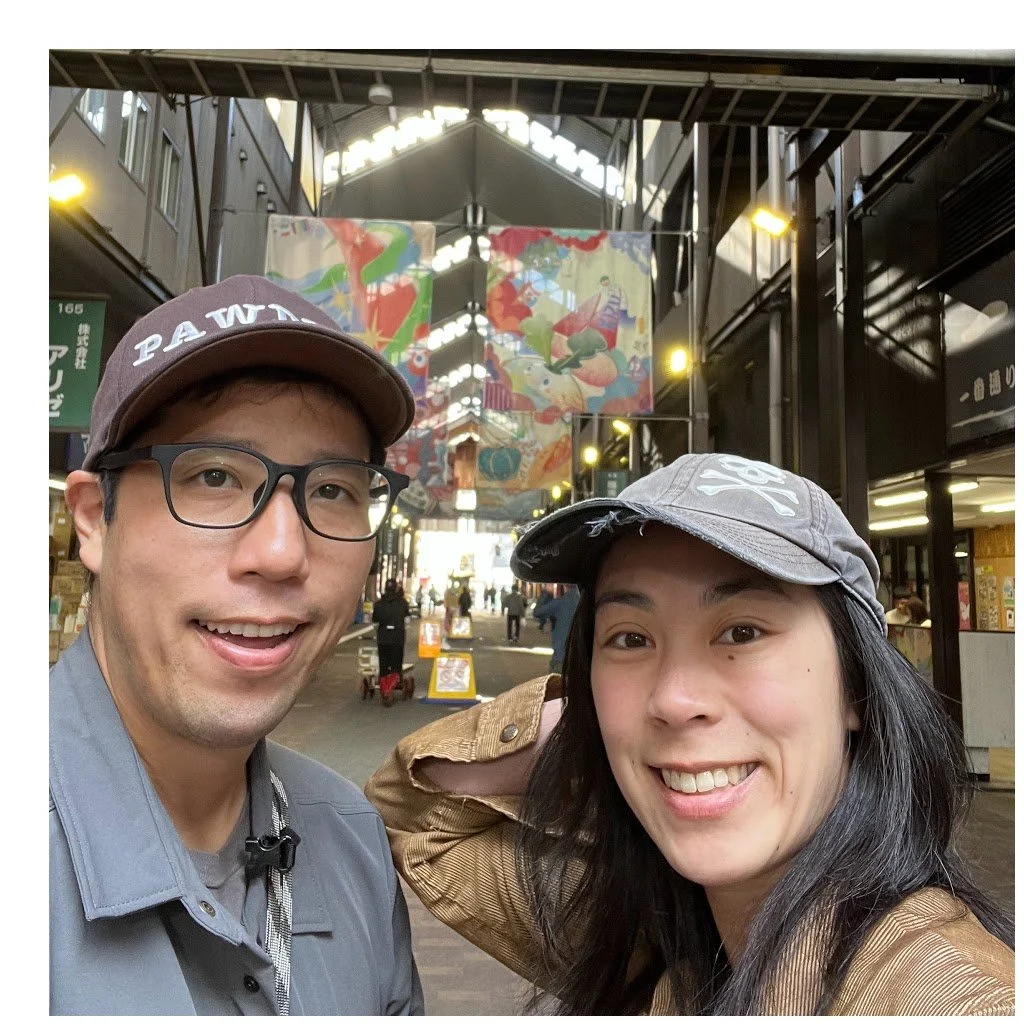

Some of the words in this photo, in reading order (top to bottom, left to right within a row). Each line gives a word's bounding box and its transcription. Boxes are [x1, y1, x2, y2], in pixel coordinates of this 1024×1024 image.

[58, 303, 84, 315] 165
[74, 323, 91, 370] 株式会社
